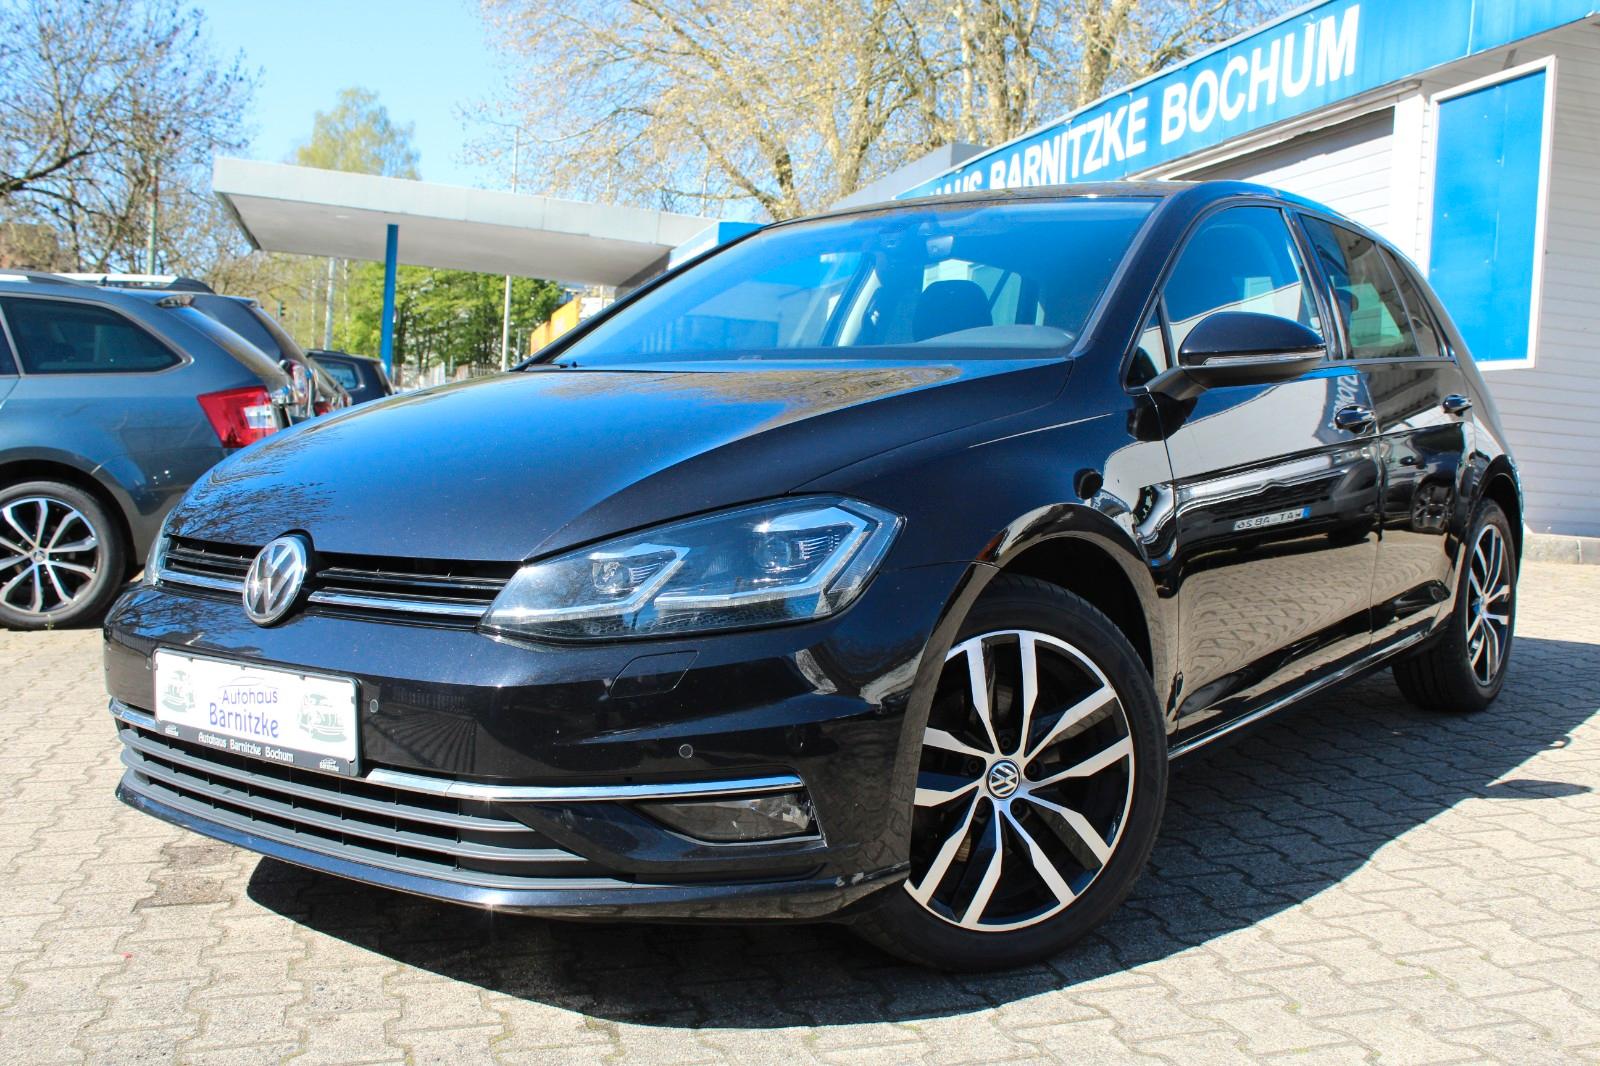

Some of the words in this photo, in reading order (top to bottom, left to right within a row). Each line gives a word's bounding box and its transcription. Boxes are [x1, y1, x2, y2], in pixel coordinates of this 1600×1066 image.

[990, 96, 1149, 190] BARNITZKE
[1160, 4, 1360, 145] BOCHUM
[221, 688, 279, 705] Autohaus
[209, 702, 280, 738] Barnitzke
[198, 732, 227, 748] Autohaus
[229, 738, 262, 756] Barnitzke
[265, 746, 294, 763] Bochum
